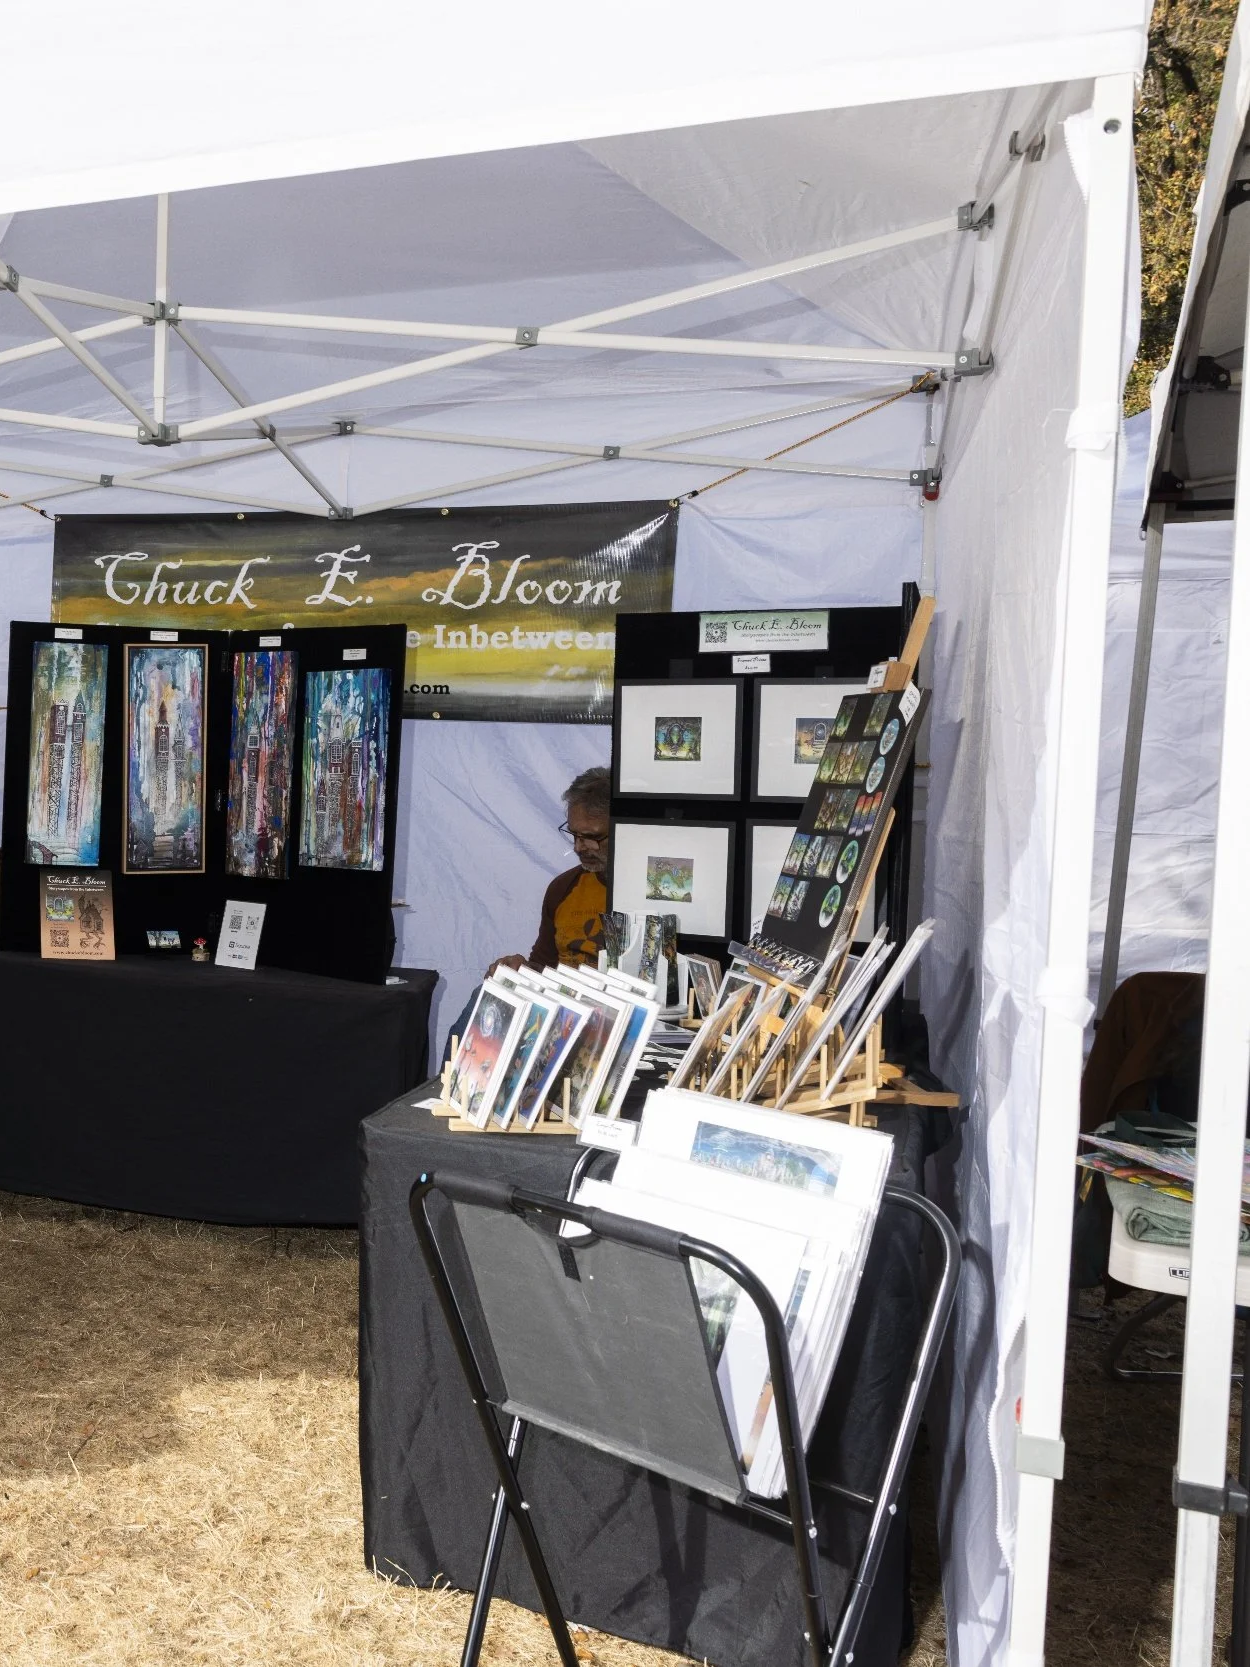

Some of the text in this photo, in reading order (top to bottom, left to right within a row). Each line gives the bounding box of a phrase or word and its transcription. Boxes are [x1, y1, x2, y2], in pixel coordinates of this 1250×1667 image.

[94, 541, 622, 610] Chuck E. Bloom
[731, 620, 768, 631] Chuck
[786, 617, 822, 630] Bloom
[433, 624, 616, 650] Inbetween
[46, 875, 71, 885] Chuck
[82, 875, 106, 885] Bloom
